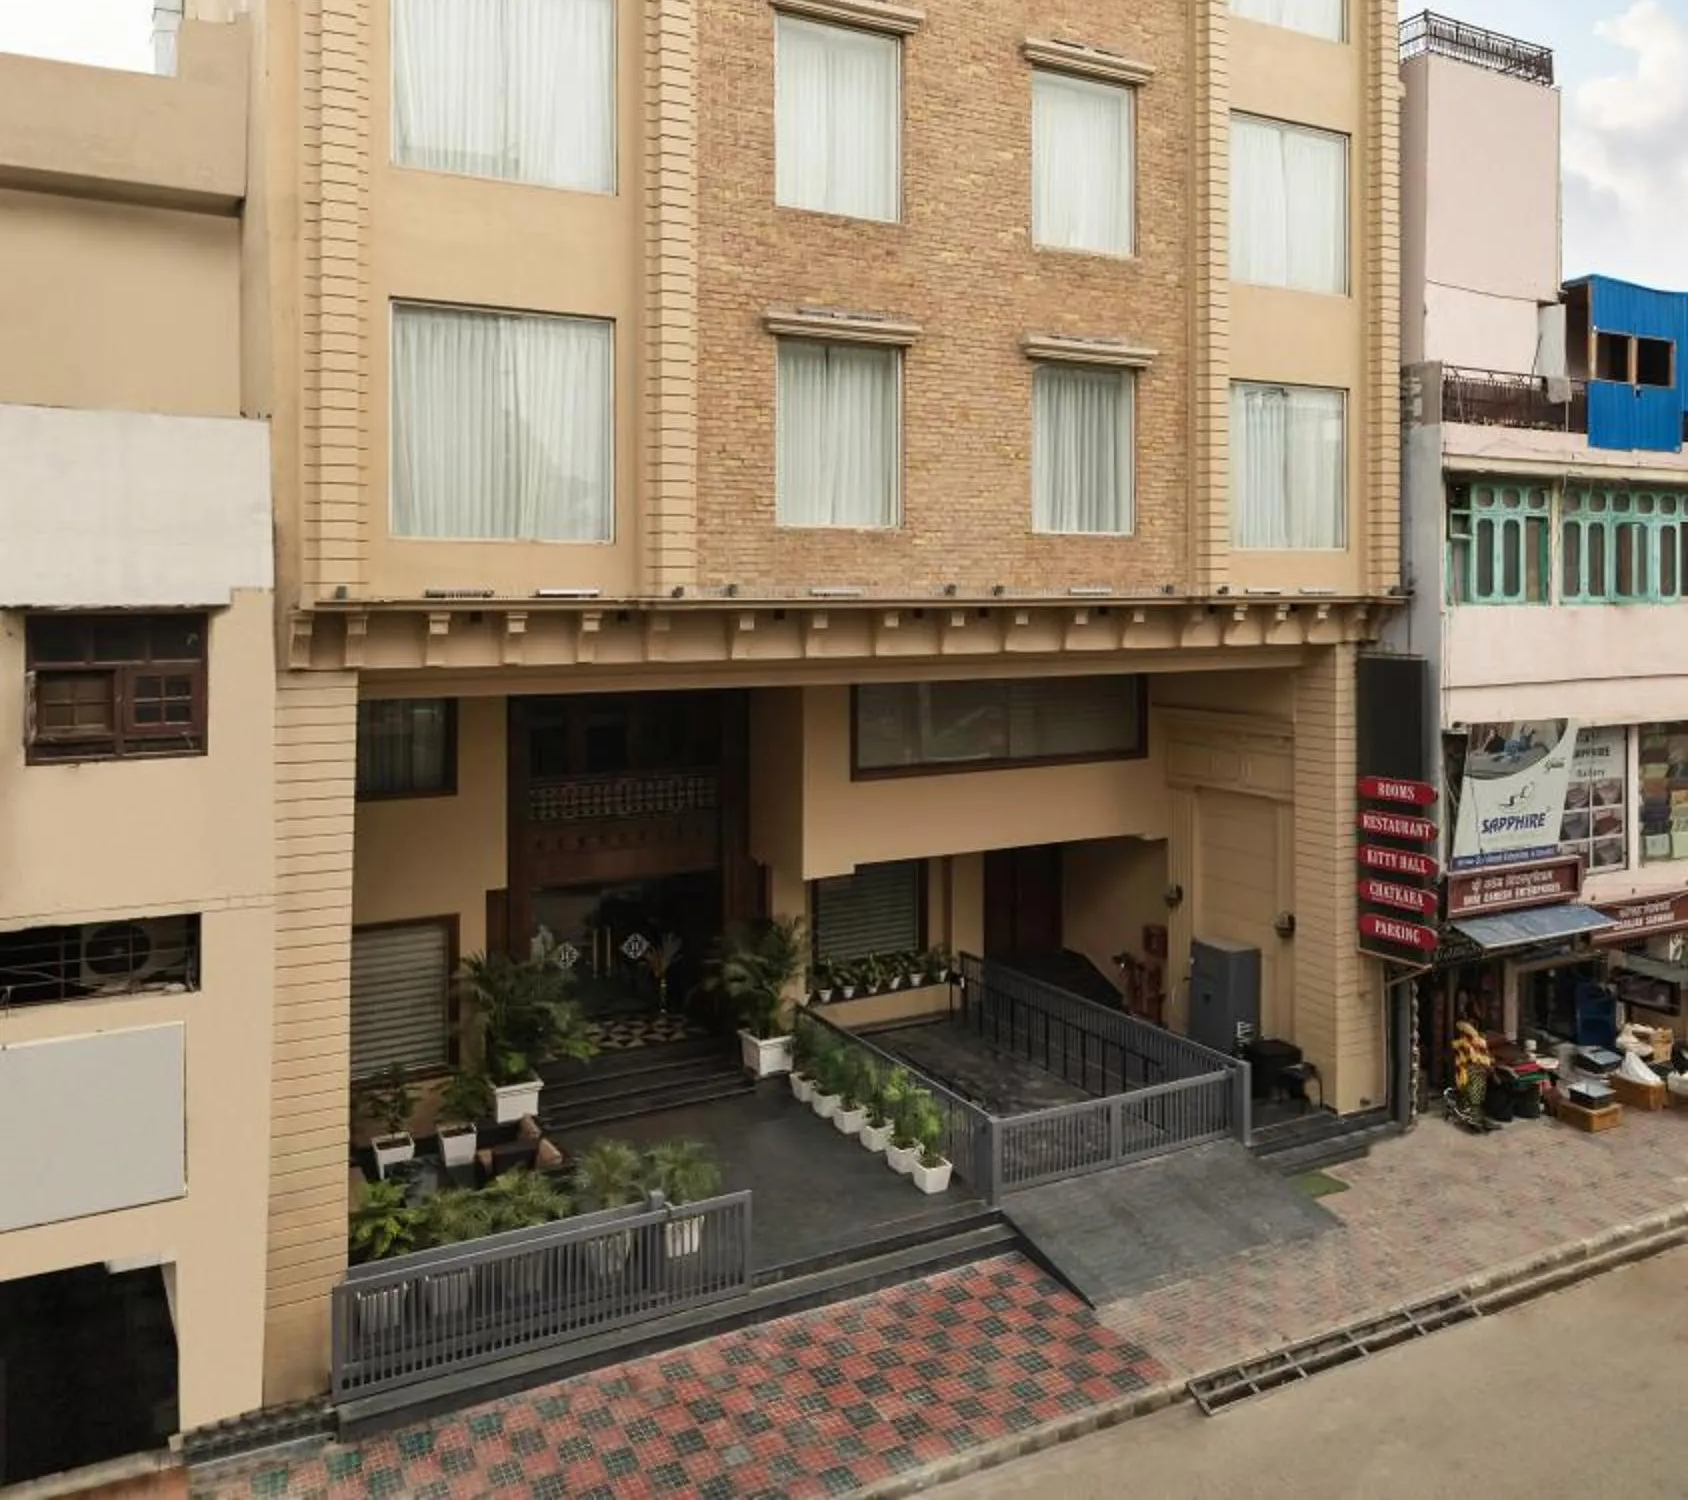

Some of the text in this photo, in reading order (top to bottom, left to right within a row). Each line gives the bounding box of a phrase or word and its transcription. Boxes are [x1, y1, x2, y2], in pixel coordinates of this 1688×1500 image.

[1377, 781, 1416, 801] ROOMS
[1363, 813, 1431, 838] RESTAURANT
[1481, 812, 1546, 835] SAPPHIRE
[1367, 848, 1428, 874] KITTY HALL
[1375, 919, 1421, 944] PARKING
